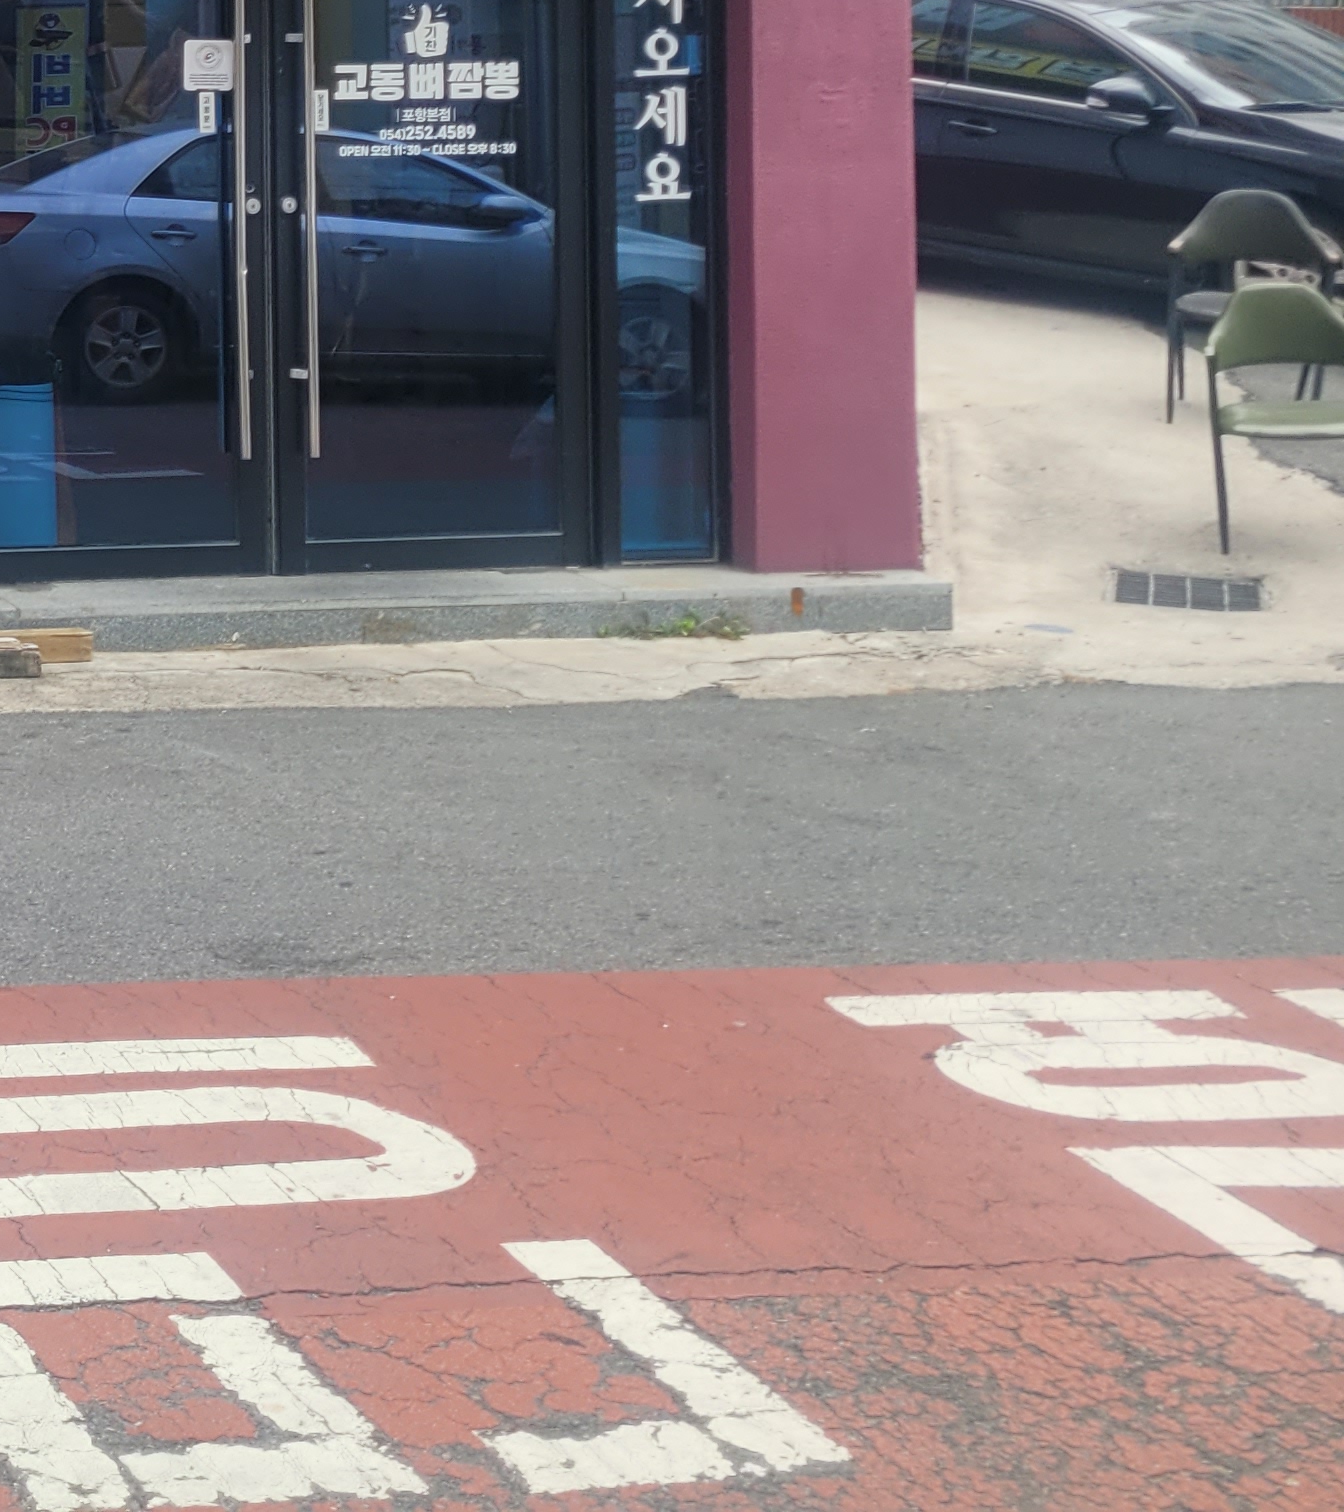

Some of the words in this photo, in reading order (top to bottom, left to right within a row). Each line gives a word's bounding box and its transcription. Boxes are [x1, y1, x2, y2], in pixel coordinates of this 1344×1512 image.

[401, 107, 451, 123] 포항본점
[338, 144, 369, 157] OPEN
[370, 144, 392, 157] 오전
[432, 143, 465, 155] CLOSE
[467, 143, 488, 155] 오후
